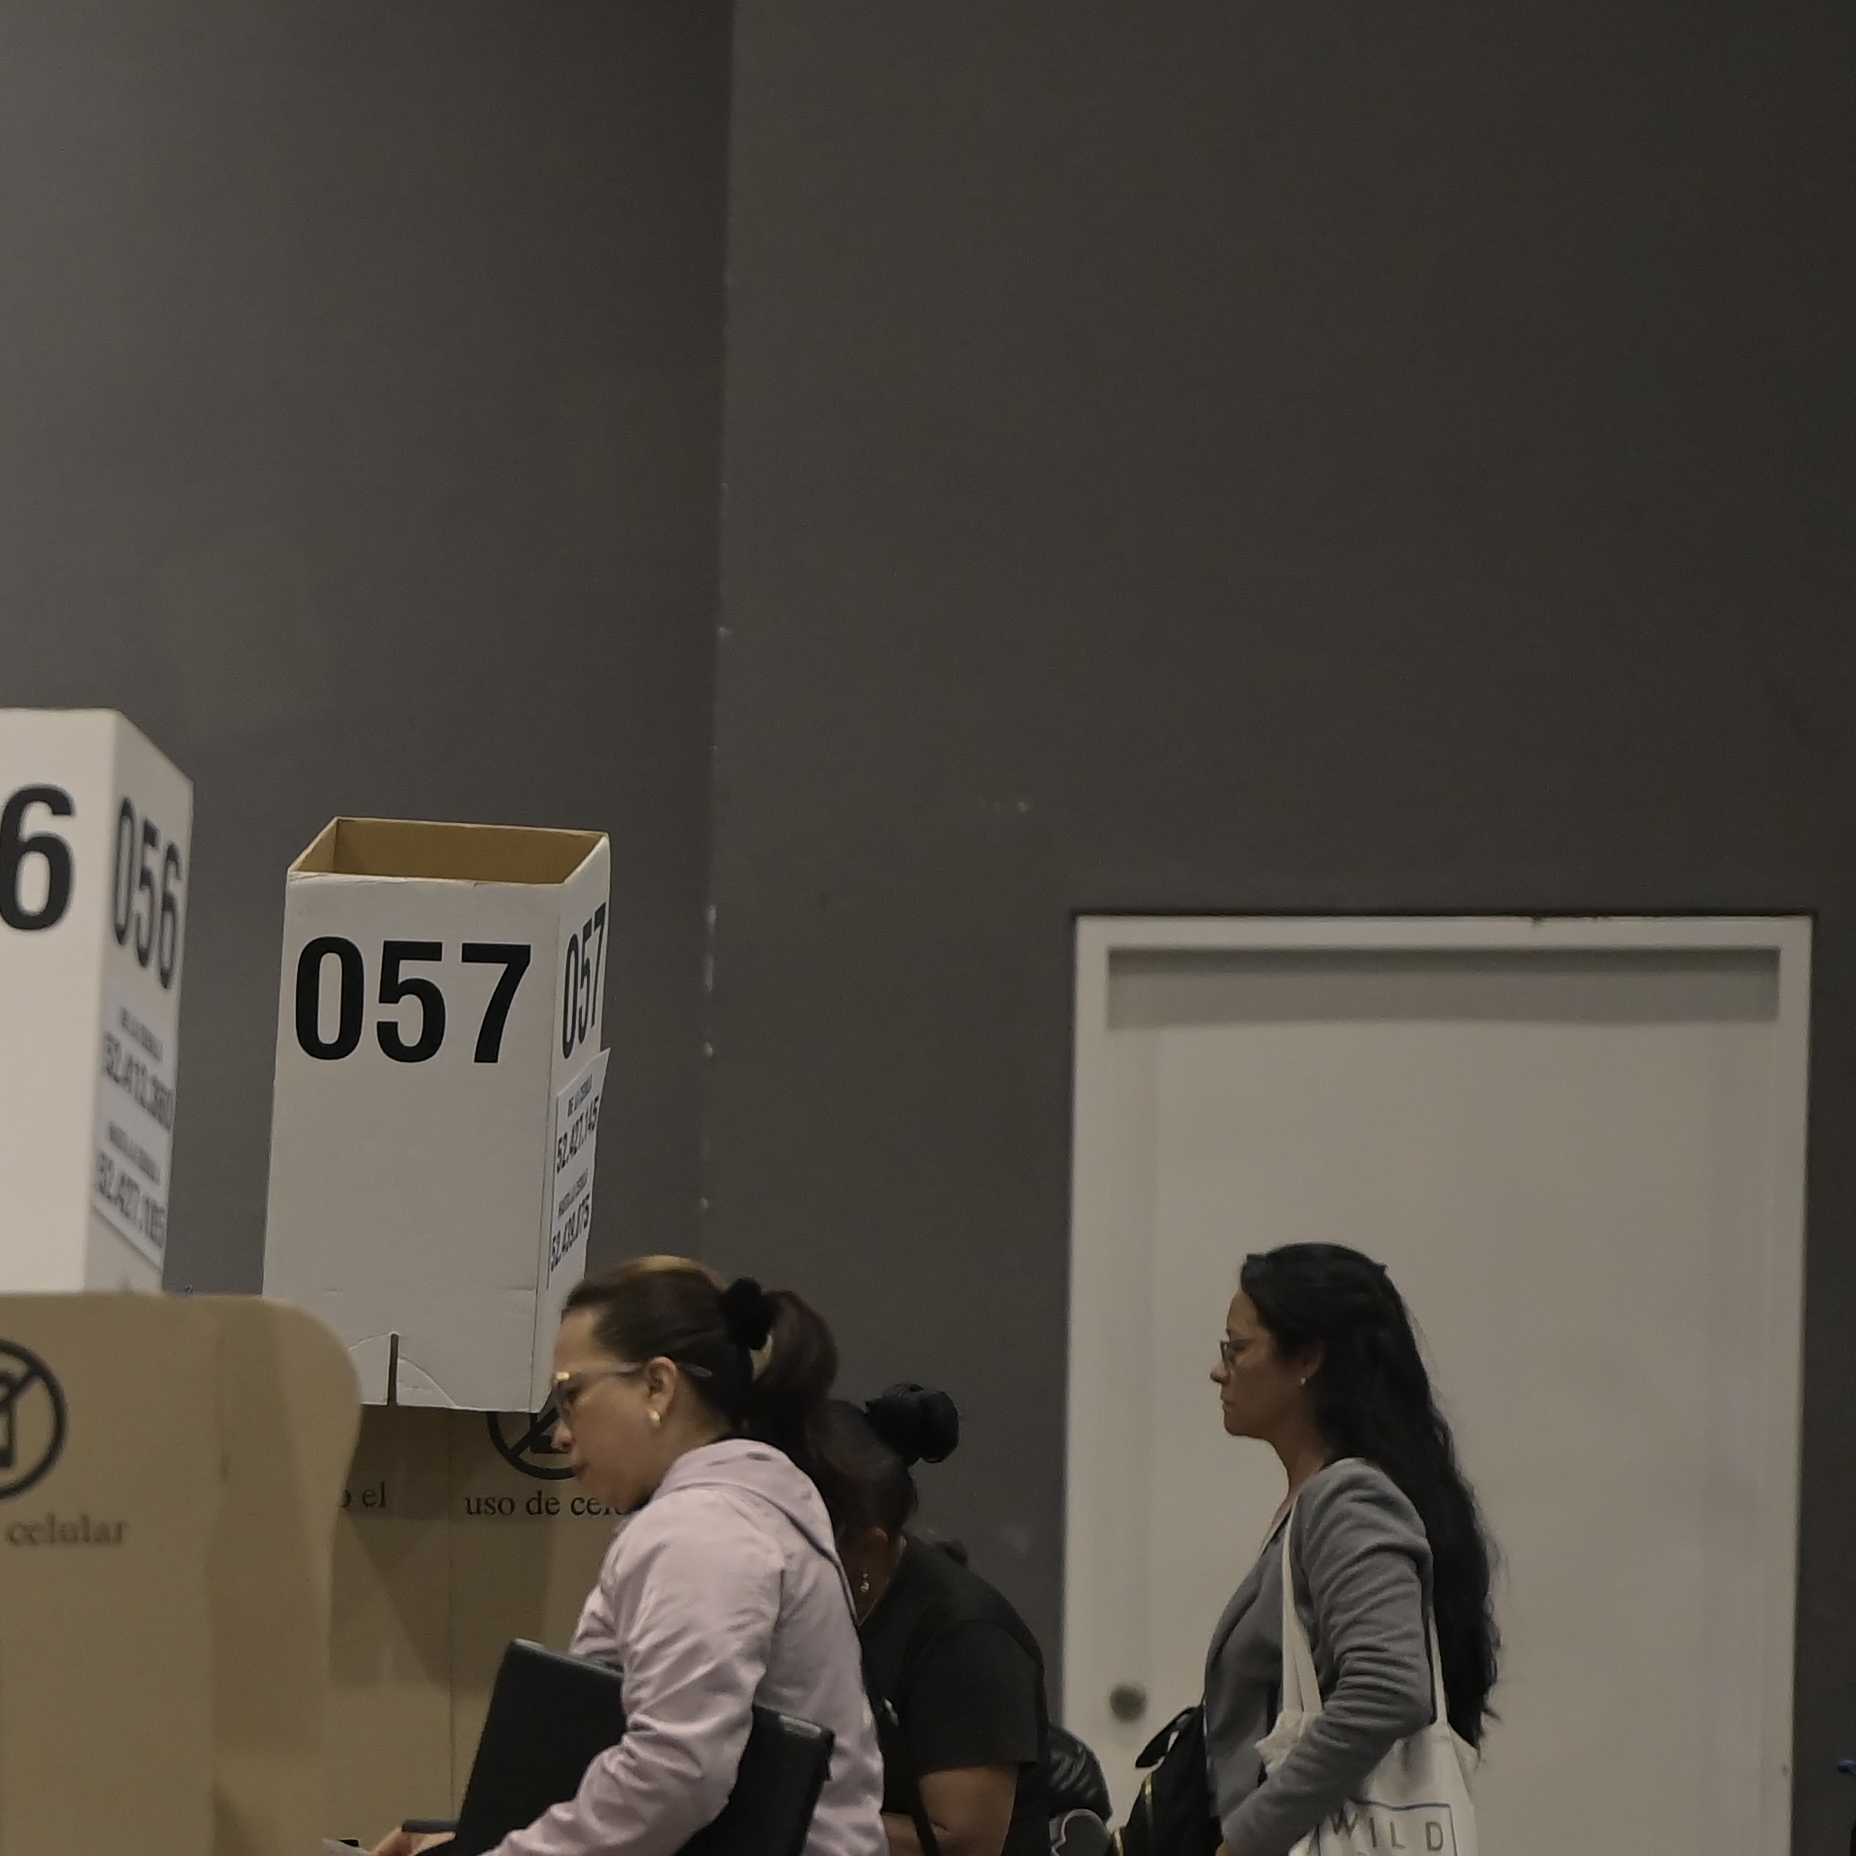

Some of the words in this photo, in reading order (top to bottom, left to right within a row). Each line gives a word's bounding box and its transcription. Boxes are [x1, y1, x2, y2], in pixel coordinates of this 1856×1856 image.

[114, 797, 182, 990] 056
[296, 937, 531, 1063] 057
[562, 902, 606, 1059] 057
[362, 1481, 386, 1508] el
[465, 1496, 515, 1516] uso
[526, 1490, 560, 1516] de
[3, 1514, 127, 1547] celular
[1331, 1812, 1444, 1851] WILD
